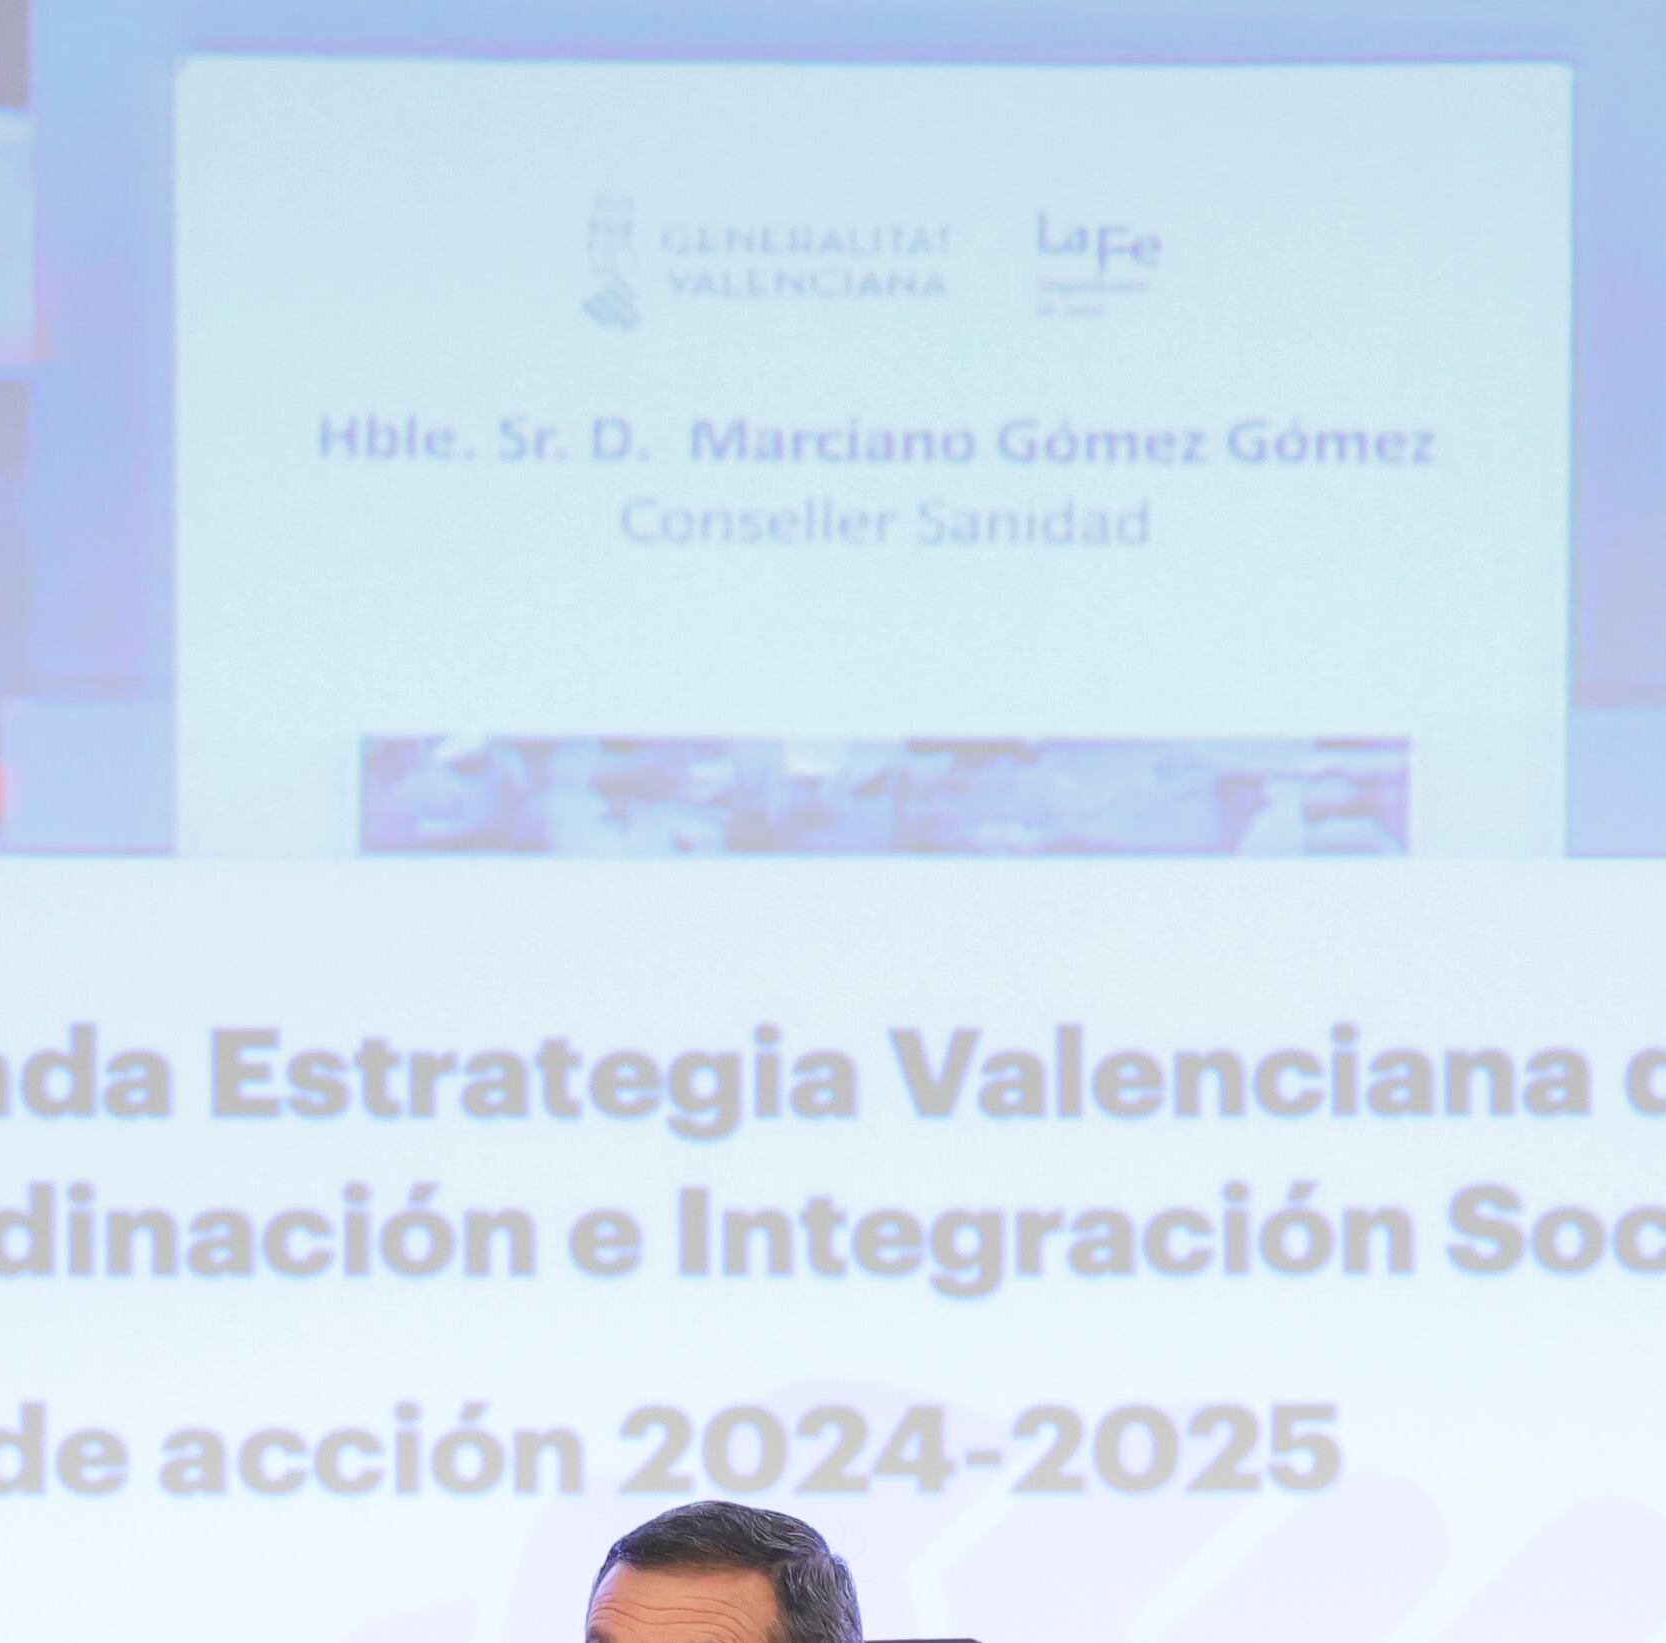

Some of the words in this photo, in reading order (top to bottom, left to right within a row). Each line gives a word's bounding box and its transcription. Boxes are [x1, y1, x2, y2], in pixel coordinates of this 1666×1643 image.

[315, 412, 475, 463] Hble.
[496, 414, 569, 464] Sr.
[588, 414, 651, 465] D.
[687, 416, 980, 466] Marciano
[994, 412, 1209, 467] Gómez
[1223, 412, 1438, 468] Gómez
[616, 494, 900, 549] Conseller
[914, 496, 1153, 549] Sanidad
[209, 1021, 860, 1144] Estrategia
[885, 1020, 1593, 1121] Valenciana
[566, 1207, 644, 1280] e
[677, 1179, 1417, 1302] Integración
[157, 1398, 586, 1498] acción
[618, 1401, 1343, 1498] 2024-2025
